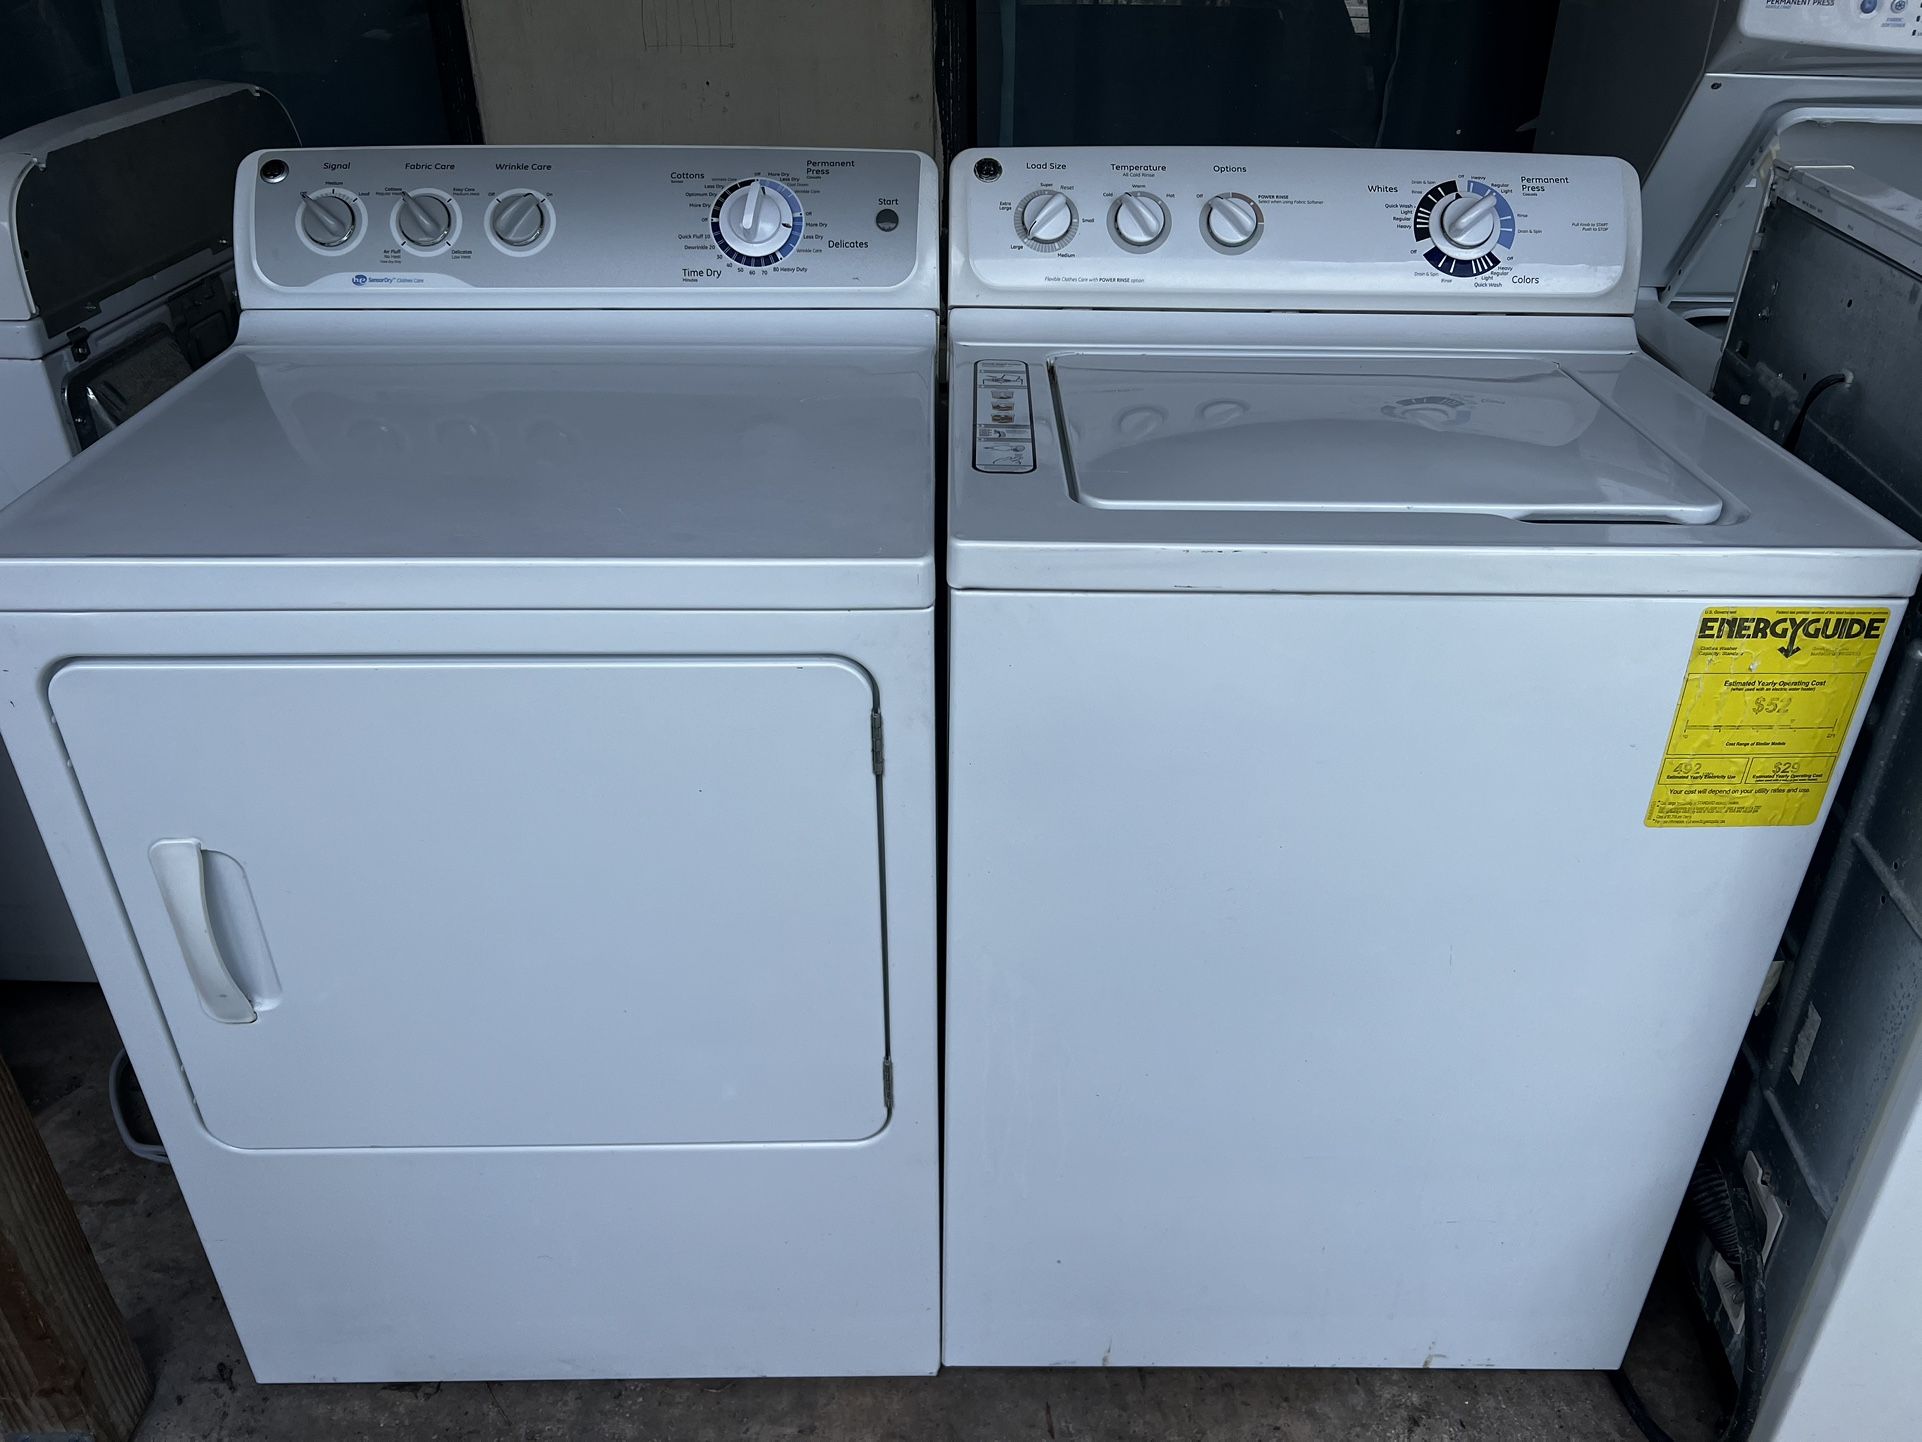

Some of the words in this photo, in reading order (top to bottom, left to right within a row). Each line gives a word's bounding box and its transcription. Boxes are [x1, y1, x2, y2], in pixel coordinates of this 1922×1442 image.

[323, 162, 351, 171] Signal
[405, 162, 432, 170] Fabric
[434, 162, 455, 170] Care
[495, 162, 529, 171] Wrinkle
[531, 163, 552, 171] Care
[806, 160, 855, 168] Permanent
[1026, 162, 1047, 170] Load
[1049, 162, 1067, 170] Size
[1110, 163, 1167, 172] Temperature
[1213, 165, 1247, 174] Options
[670, 171, 705, 180] Cottons
[1521, 176, 1569, 184] Permanent
[1367, 185, 1399, 193] Whites
[1521, 184, 1545, 192] Press
[878, 198, 899, 206] Start
[828, 240, 869, 249] Delicates
[682, 268, 704, 277] Time
[706, 268, 722, 278] Dry
[1512, 275, 1540, 284] Colors
[1698, 617, 1887, 641] ENERGYGUIDE
[1757, 680, 1777, 688] Yearly
[1778, 680, 1810, 688] Operating
[1752, 696, 1792, 715] $52
[1673, 762, 1702, 775] 492
[1772, 761, 1801, 774] $29
[1708, 788, 1731, 796] depend
